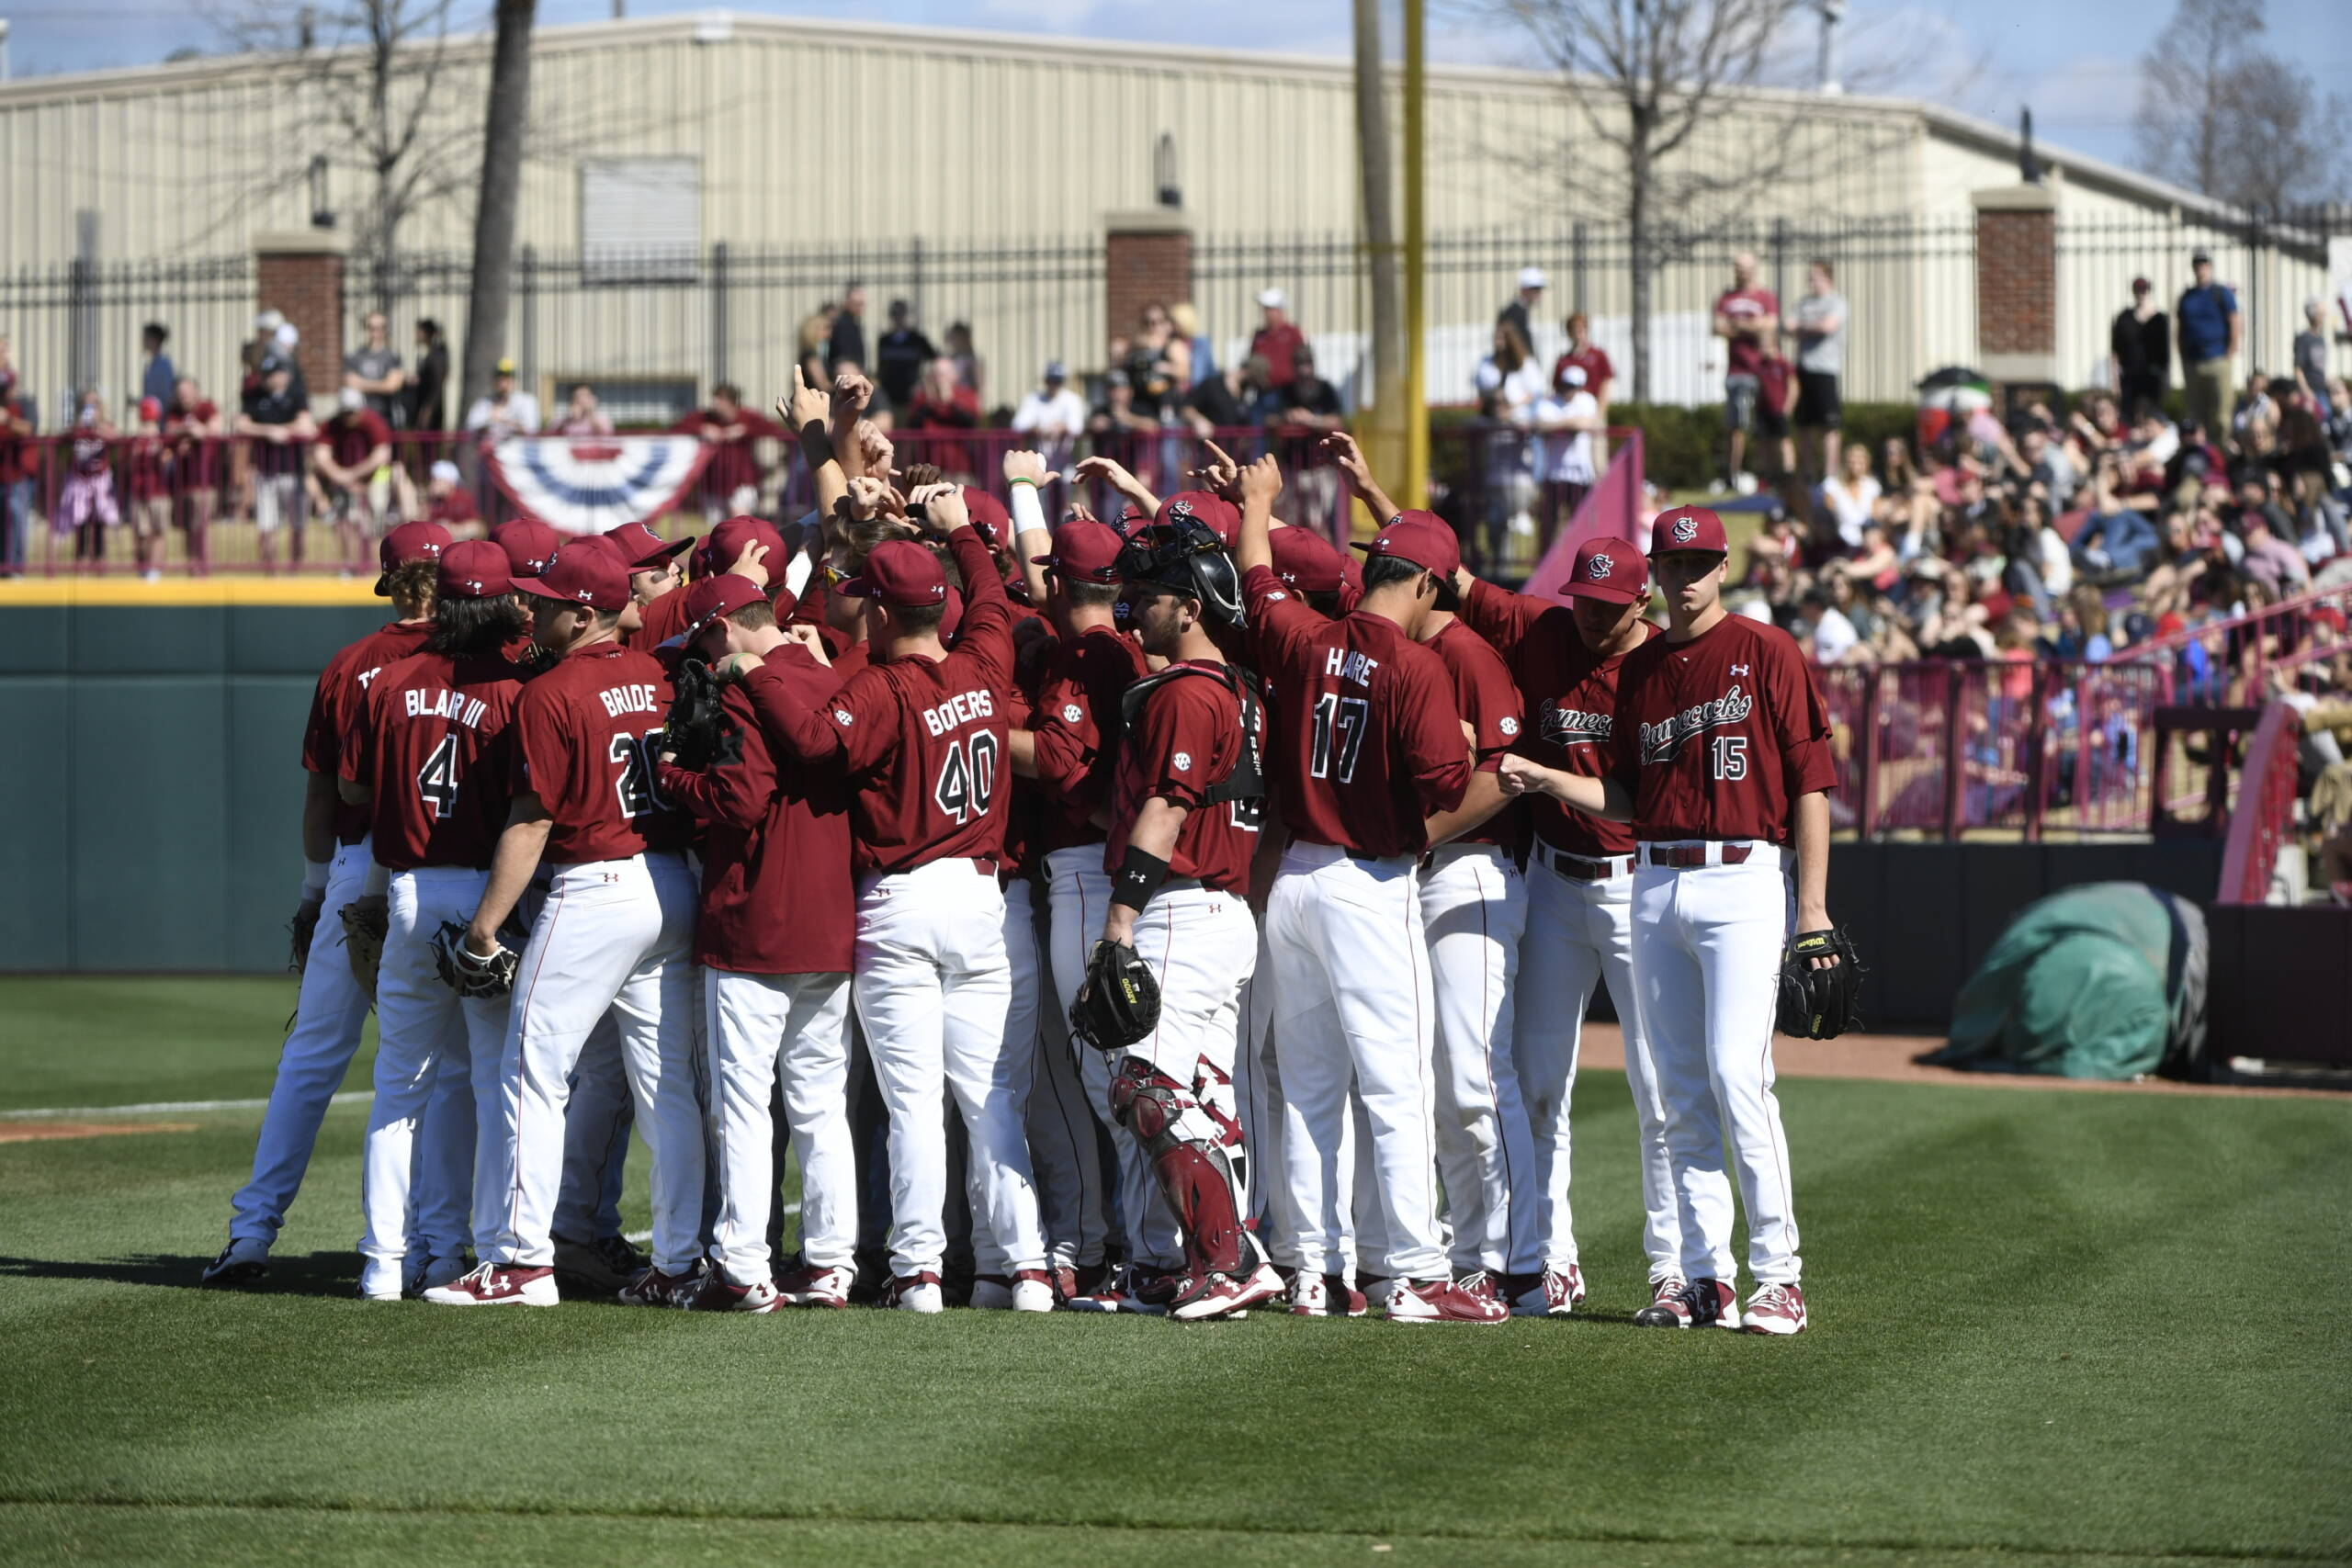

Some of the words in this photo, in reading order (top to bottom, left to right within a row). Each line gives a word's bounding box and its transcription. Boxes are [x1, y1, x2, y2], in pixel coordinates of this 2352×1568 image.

[405, 688, 465, 720] BLAIR
[462, 698, 487, 728] III
[599, 684, 658, 717] BRIDE
[1310, 692, 1369, 784] 17
[1639, 684, 1752, 766] Gamecocks
[416, 732, 458, 818] 4
[934, 728, 998, 825] 40
[1173, 751, 1192, 772] SEC
[1712, 736, 1747, 780] 15
[1797, 937, 1826, 949] Wilson
